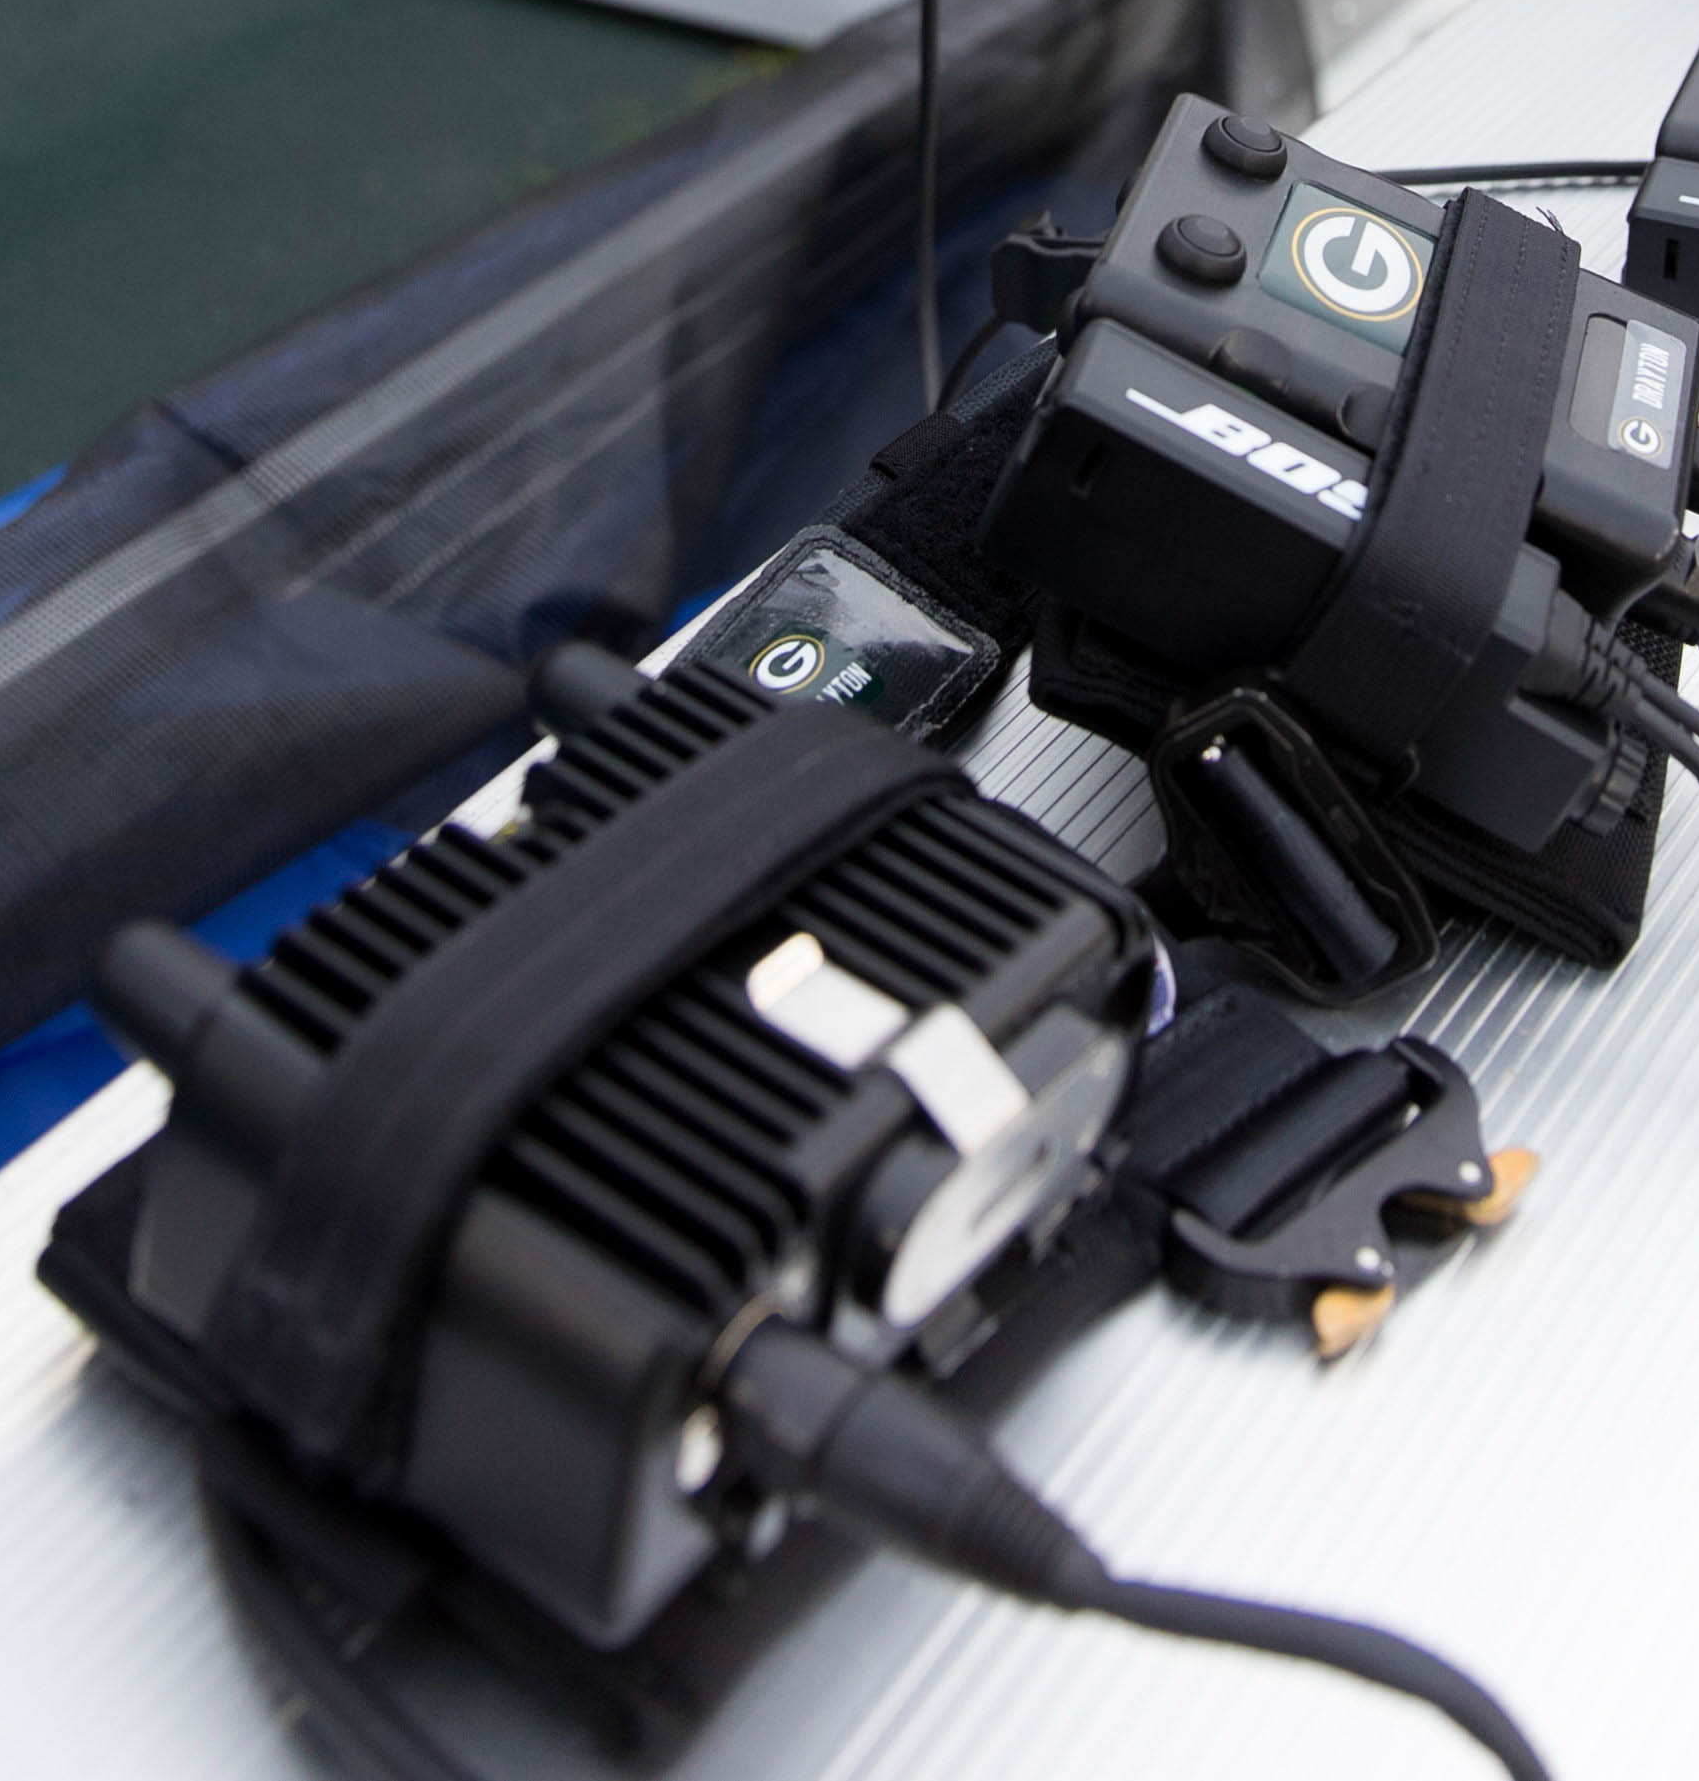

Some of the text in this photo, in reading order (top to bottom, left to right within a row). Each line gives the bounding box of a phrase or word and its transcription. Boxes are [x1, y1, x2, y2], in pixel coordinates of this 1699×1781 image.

[1303, 215, 1412, 313] G
[1631, 342, 1670, 410] DRAYTON
[1125, 387, 1369, 521] BOS
[755, 639, 873, 706] G YTON
